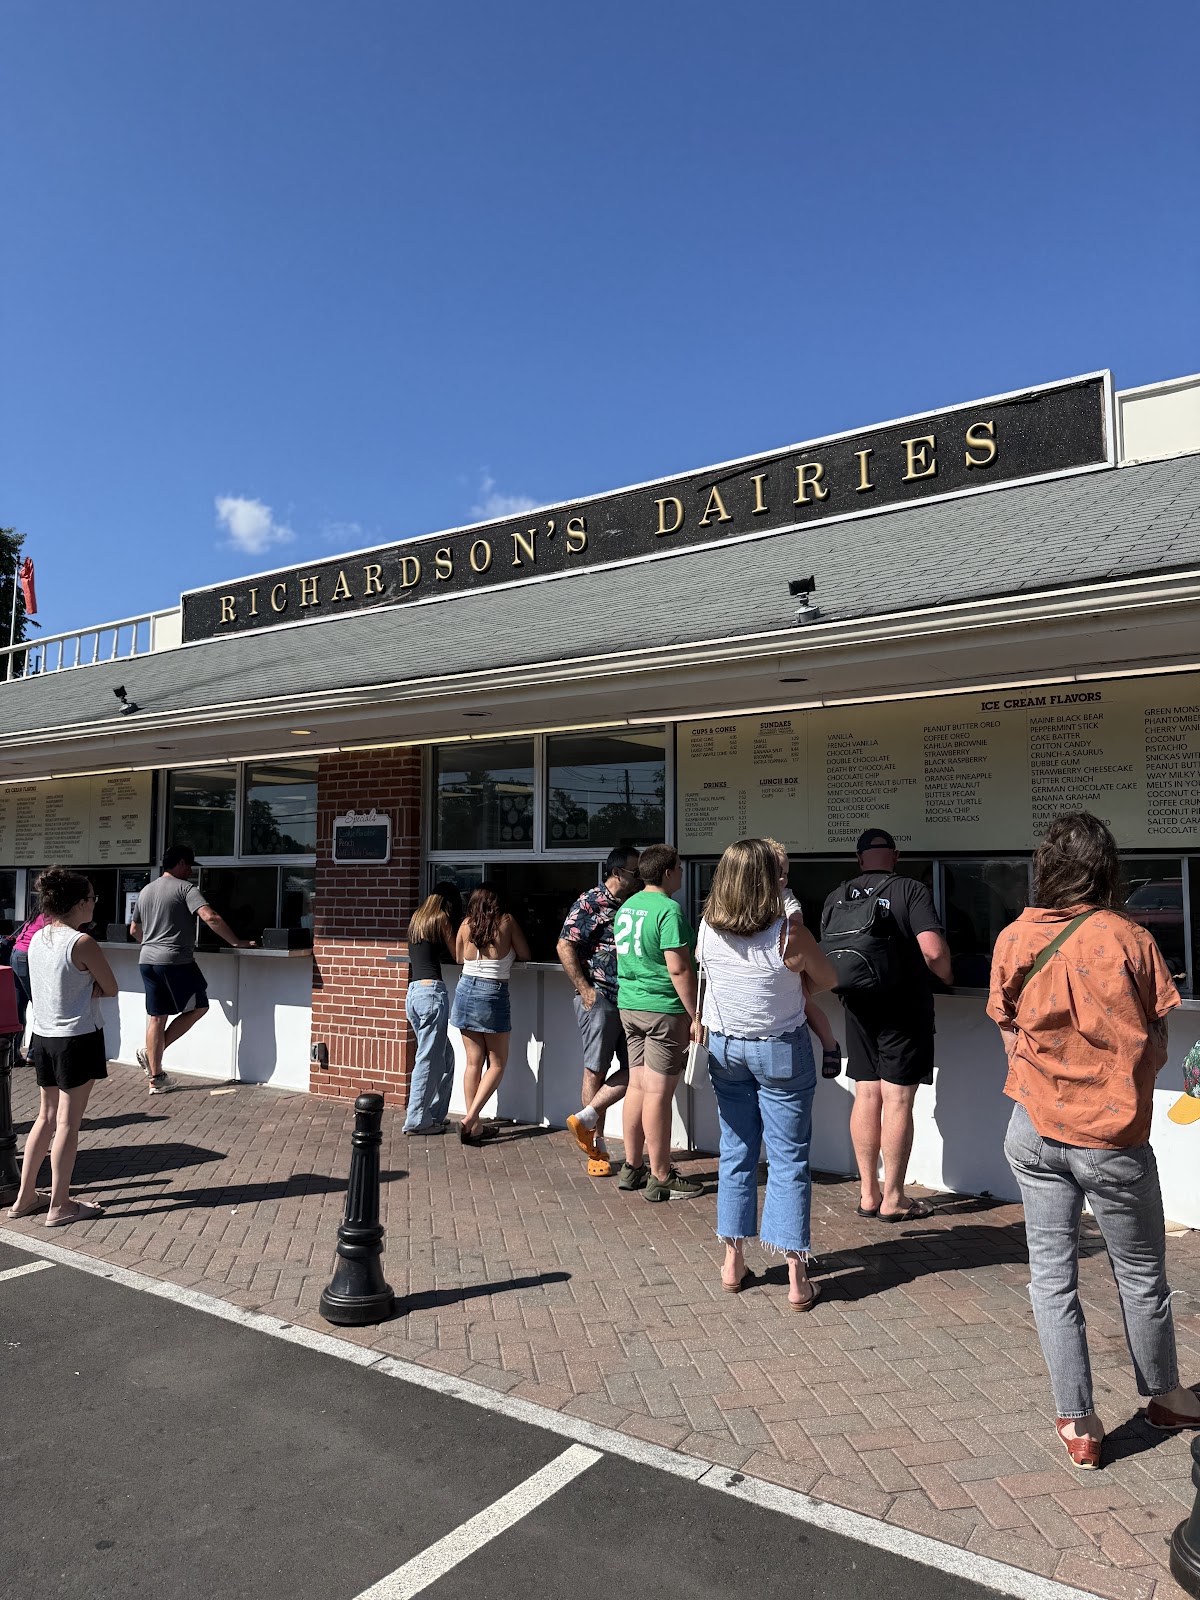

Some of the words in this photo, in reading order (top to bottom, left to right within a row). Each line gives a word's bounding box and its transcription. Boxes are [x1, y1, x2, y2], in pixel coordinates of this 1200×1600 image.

[218, 515, 590, 624] RICHARDSON'S
[654, 420, 998, 536] DAIRIES
[982, 701, 1000, 711] ICE
[1004, 697, 1046, 709] CREAM
[1051, 692, 1101, 705] FLAVORS
[1145, 708, 1172, 716] GREEN
[924, 725, 950, 733] PEANUT
[952, 723, 978, 731] BUTTER
[1030, 724, 1076, 733] PEPPERMINT
[1145, 726, 1176, 734] CHERRY
[1146, 735, 1185, 743] COCONUT
[954, 740, 987, 748] BROWNIE
[1146, 744, 1188, 752] PISTACHIO
[925, 749, 970, 758] STRAWBERRY
[948, 756, 987, 764] RASPBERRY
[1032, 768, 1081, 776] STRAWBERRY
[1084, 765, 1133, 774] CHEESECAKE
[1068, 784, 1114, 792] CHOCOLATE
[345, 808, 377, 828] Specials
[614, 914, 644, 956] 21
